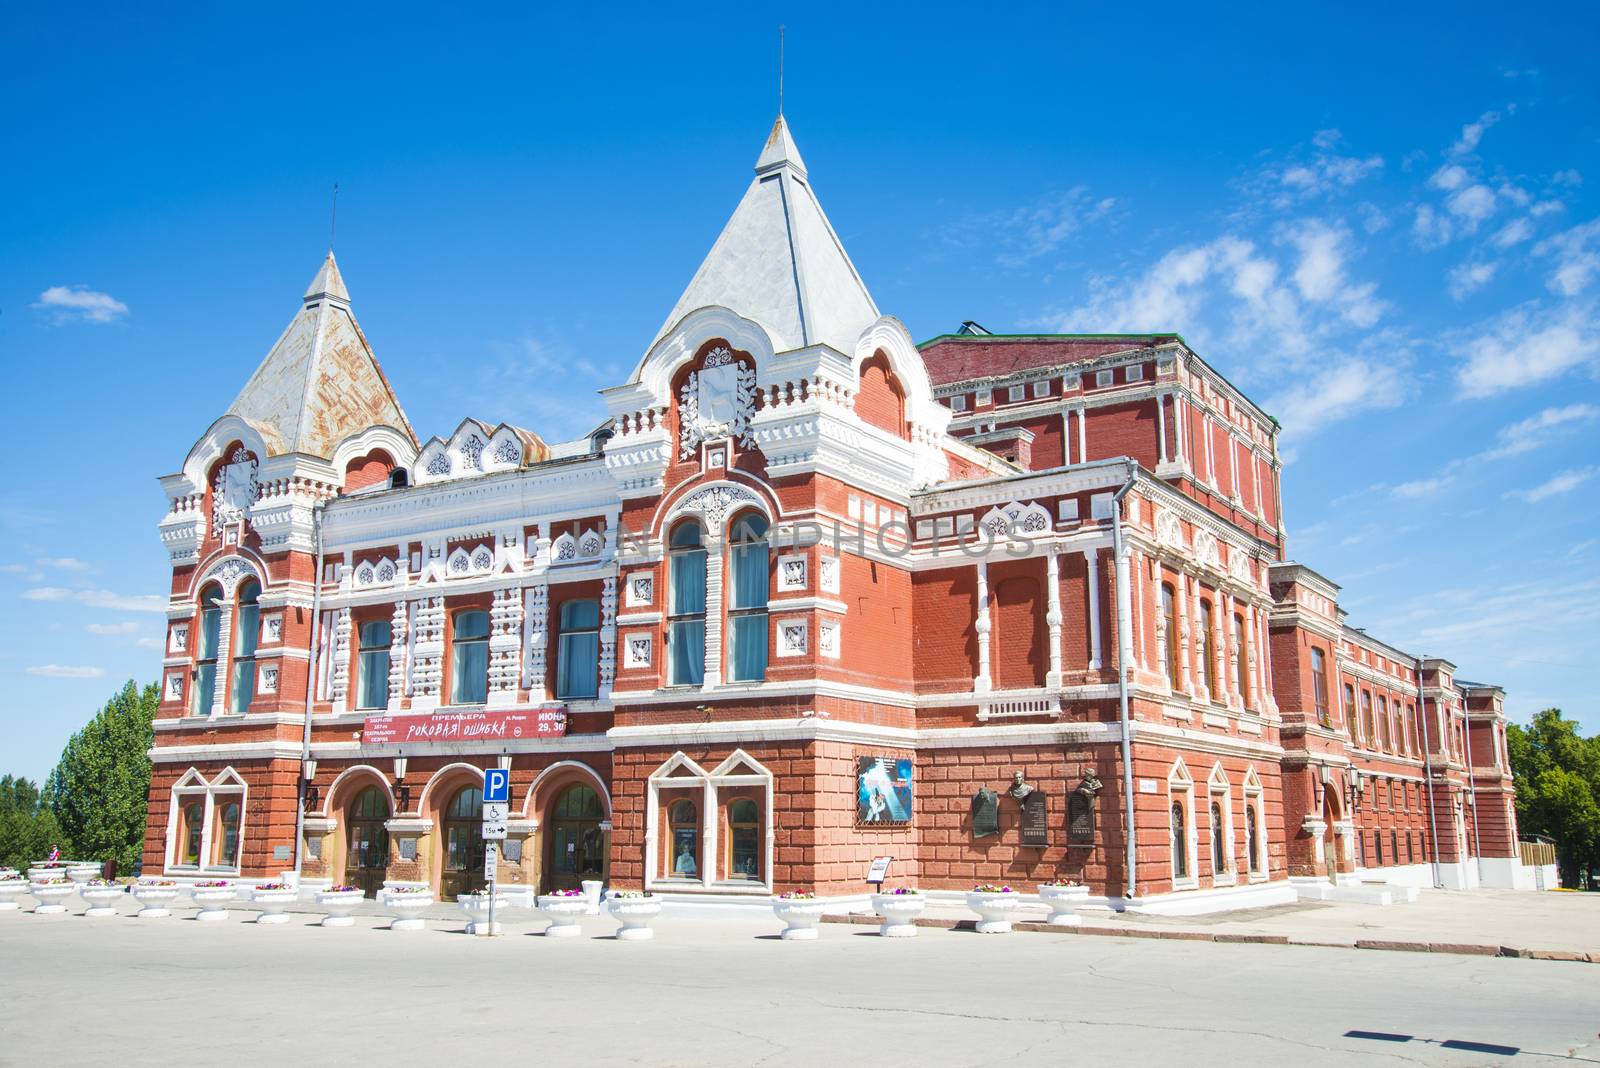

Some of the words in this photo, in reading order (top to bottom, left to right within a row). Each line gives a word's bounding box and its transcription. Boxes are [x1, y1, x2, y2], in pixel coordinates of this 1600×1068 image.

[432, 713, 486, 722] ПРЕМЬЕРА
[538, 711, 565, 721] ИЮНЬ
[406, 721, 458, 742] РОКОВАЯ
[463, 720, 507, 737] ОШИБКА
[537, 722, 551, 733] 29,
[553, 722, 564, 731] 30
[489, 772, 504, 799] P
